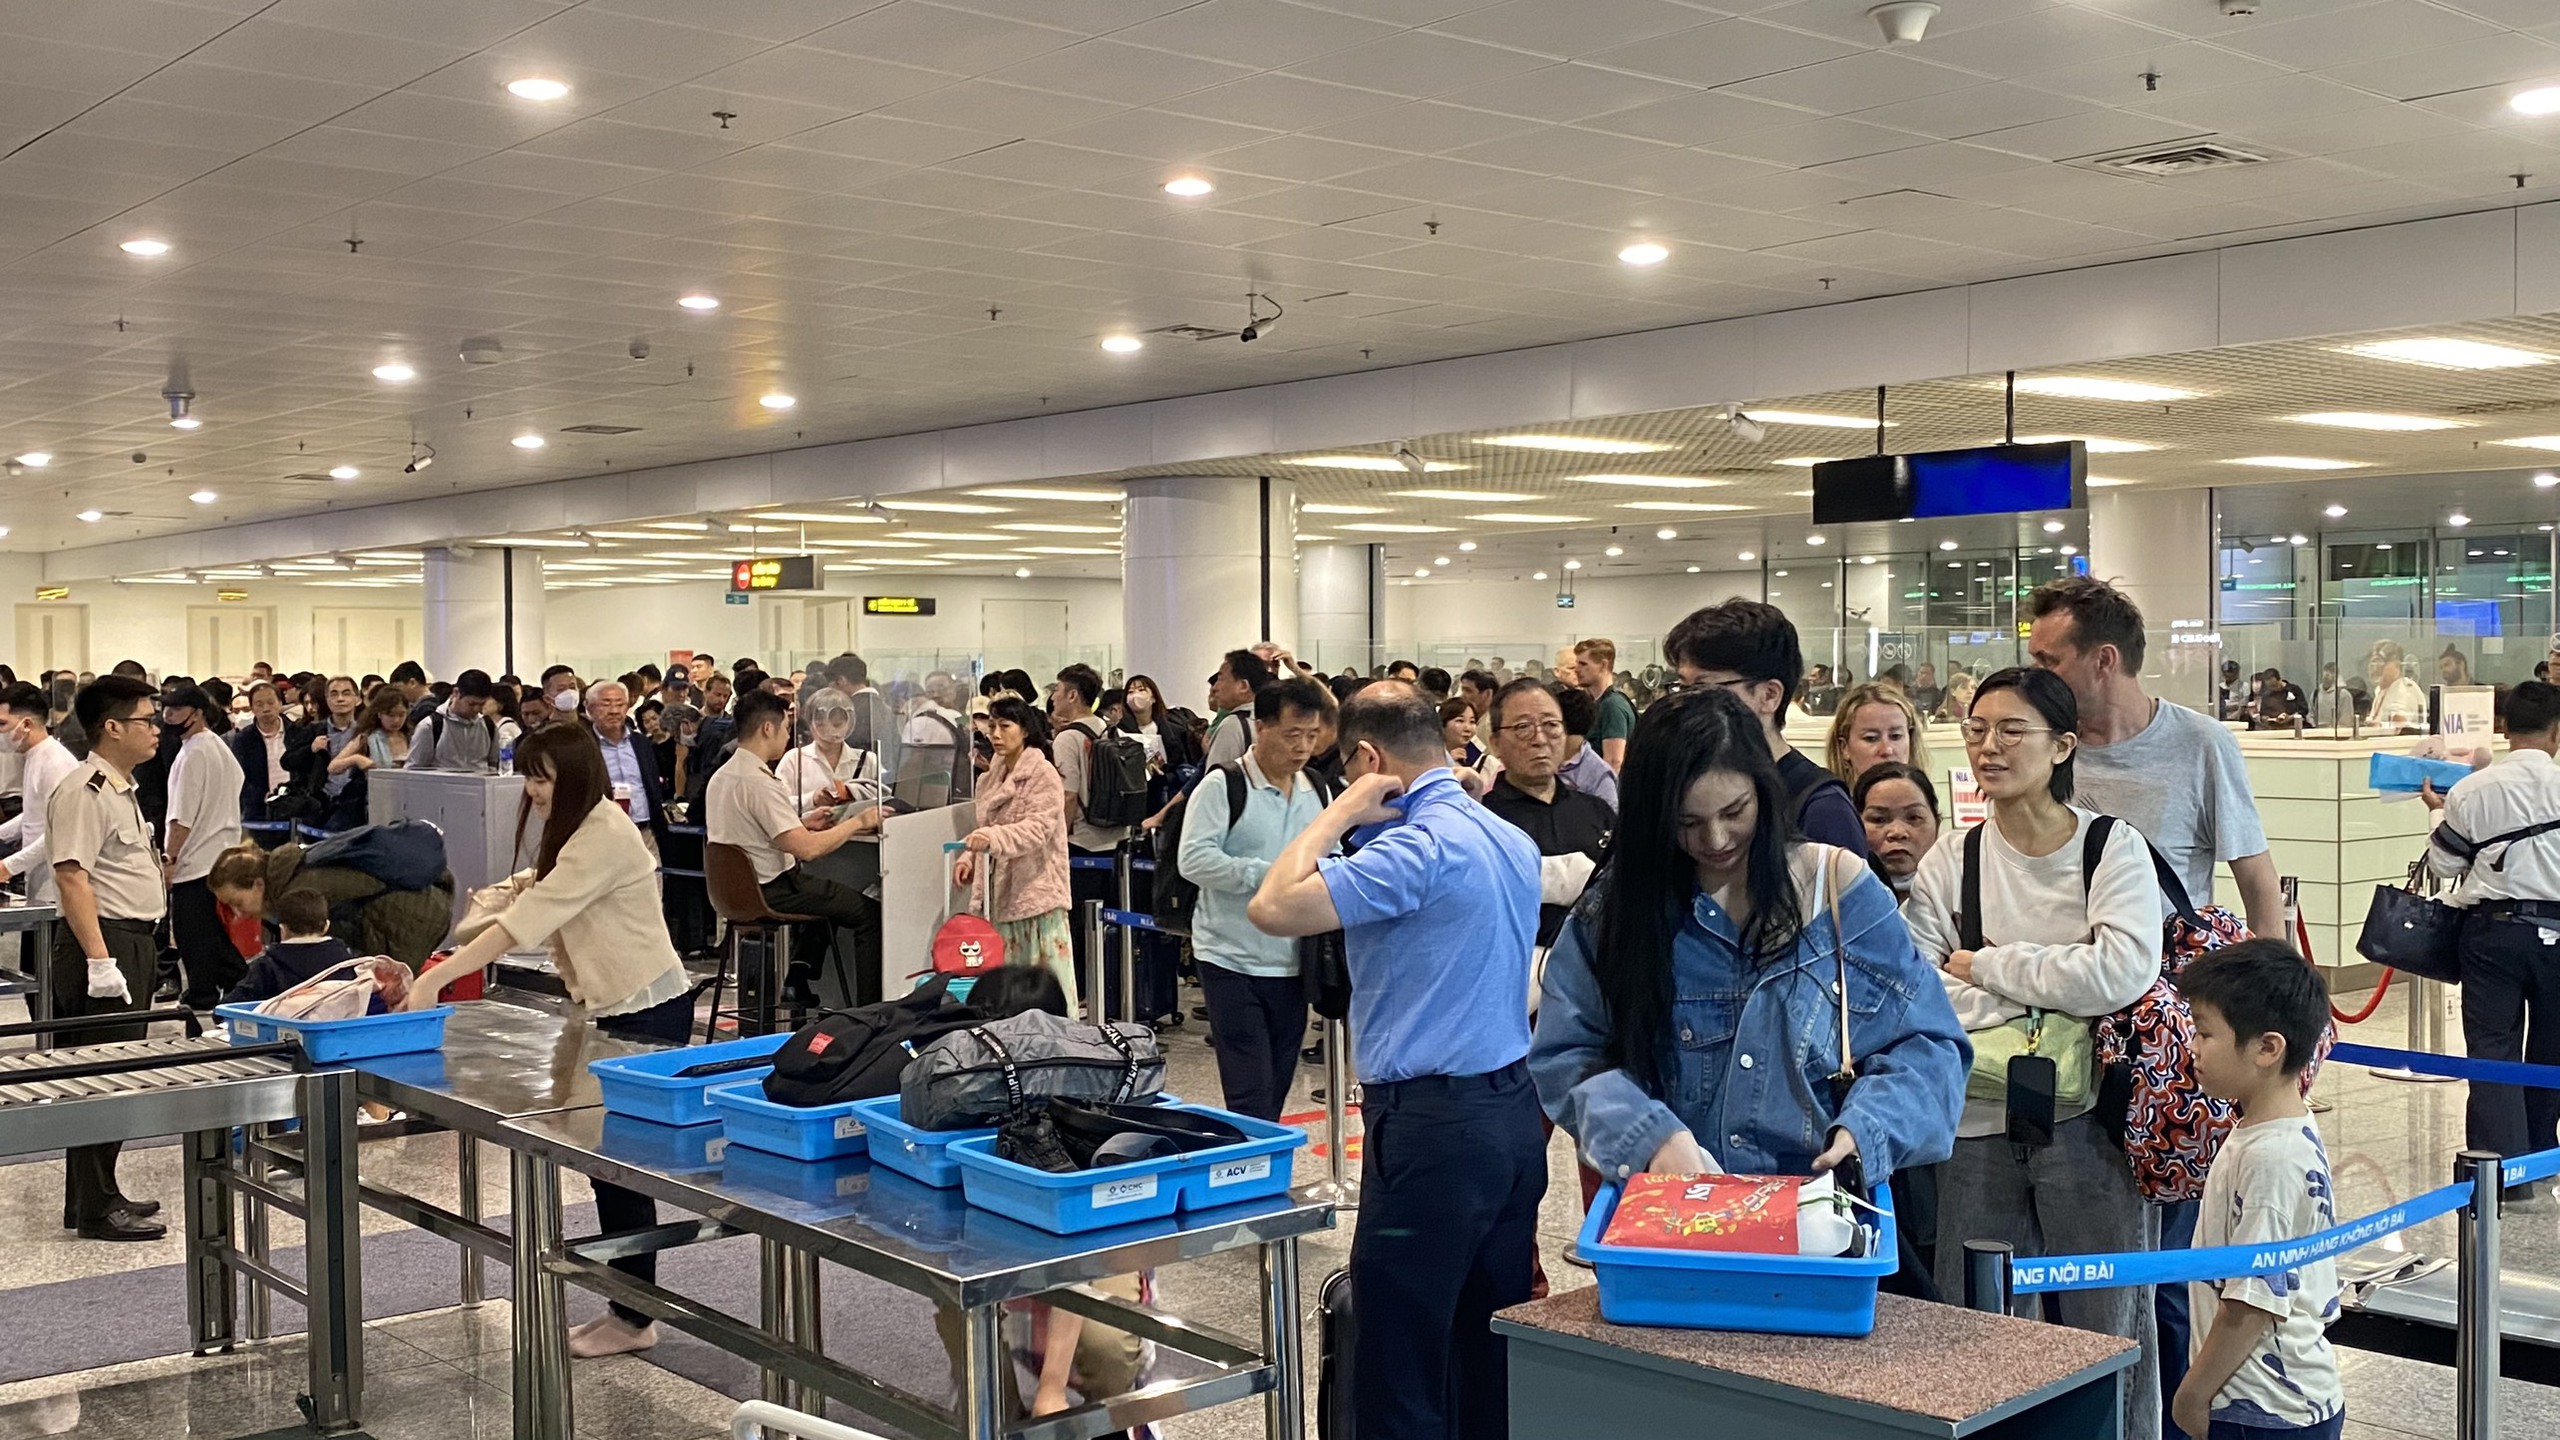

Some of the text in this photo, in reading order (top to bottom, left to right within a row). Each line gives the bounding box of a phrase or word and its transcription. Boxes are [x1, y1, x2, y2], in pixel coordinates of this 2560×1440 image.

[2444, 713, 2464, 734] NIA
[1955, 772, 1969, 782] NIA
[1004, 1063, 1022, 1105] SIMPLE
[1226, 1165, 1247, 1178] ACV
[2510, 1163, 2527, 1181] BÀI
[2251, 1209, 2406, 1269] AN NINH HÀNG KHÔNG NỘI BÀI
[2049, 1261, 2080, 1286] NỘI
[2083, 1260, 2114, 1282] BÀI
